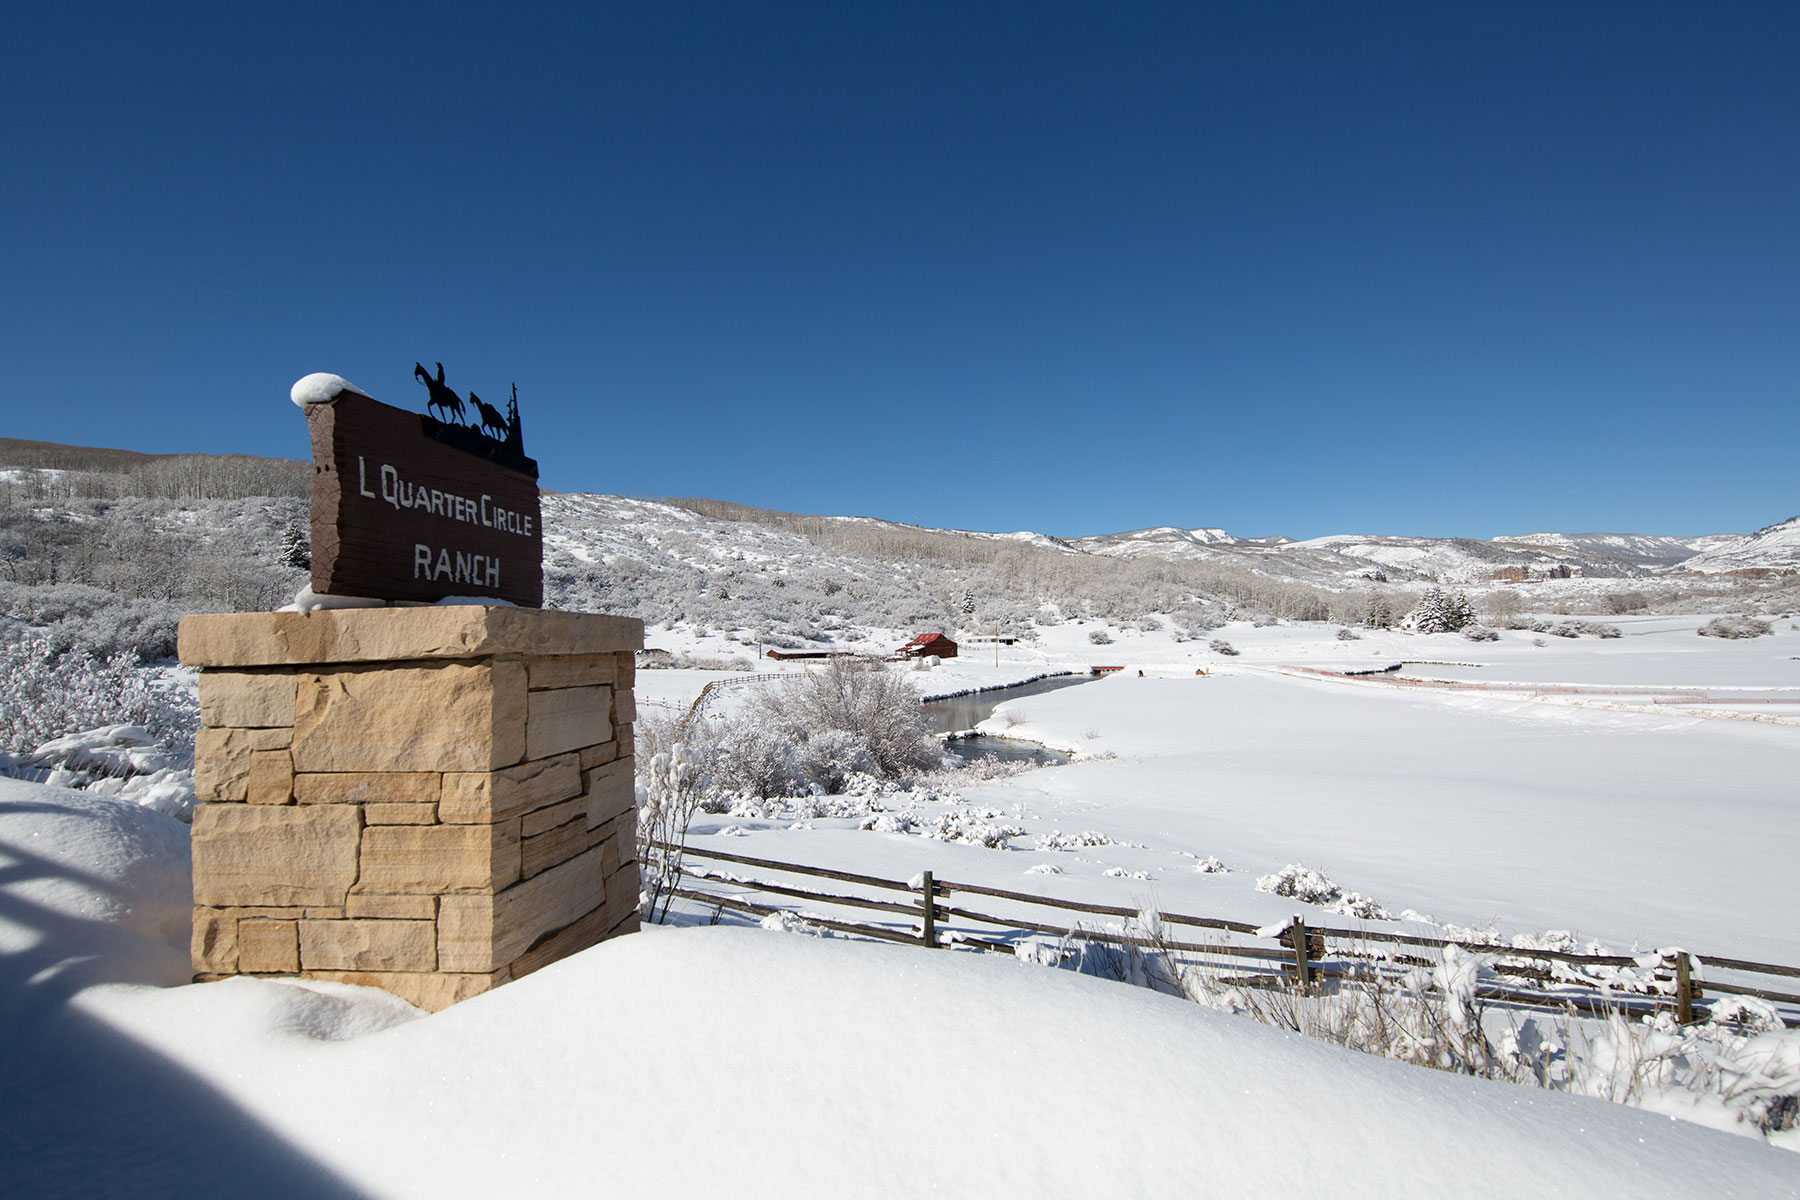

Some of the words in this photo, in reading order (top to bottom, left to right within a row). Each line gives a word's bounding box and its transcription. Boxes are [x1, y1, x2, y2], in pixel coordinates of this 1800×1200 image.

[358, 456, 376, 499] L
[381, 463, 478, 525] QUARTER
[480, 494, 532, 537] CIRCLE
[413, 543, 500, 588] RANCH
